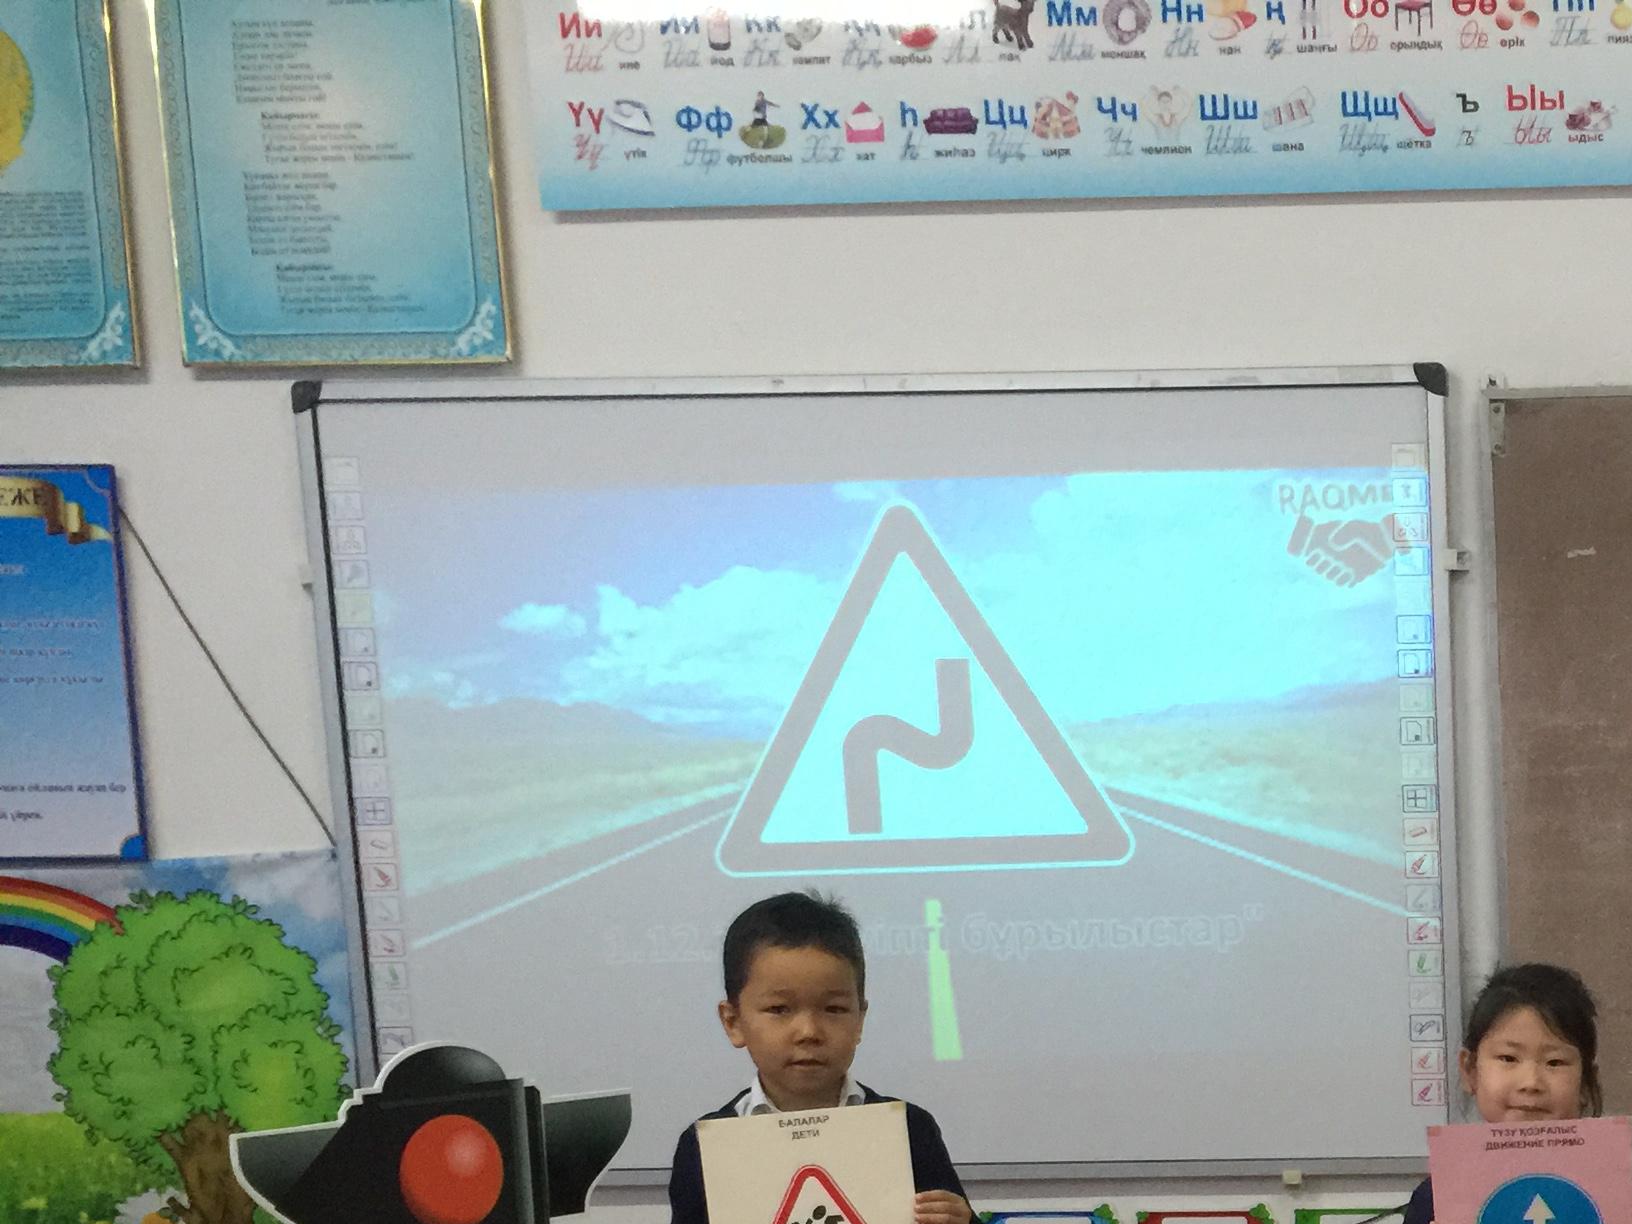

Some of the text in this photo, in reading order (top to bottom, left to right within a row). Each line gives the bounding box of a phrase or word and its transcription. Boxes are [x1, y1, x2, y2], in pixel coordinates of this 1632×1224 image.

[1046, 0, 1098, 26] Мм
[1162, 0, 1204, 24] Нн
[1344, 0, 1390, 19] Оо
[1219, 45, 1242, 56] нан
[1390, 40, 1444, 51] орындық
[675, 105, 733, 138] Фф
[801, 103, 841, 130] Хх
[983, 99, 1028, 129] Цц
[1097, 96, 1138, 121] Чч
[1199, 93, 1258, 120] Шш
[1341, 91, 1399, 121] Щщ
[1507, 84, 1565, 111] Ыы
[1568, 133, 1604, 144] ыдыс
[778, 1114, 830, 1129] БАЛАЛАР
[791, 1130, 820, 1142] ДЕТИ
[1484, 1137, 1586, 1152] ДВИЖЕНИЕ ПРЯМО
